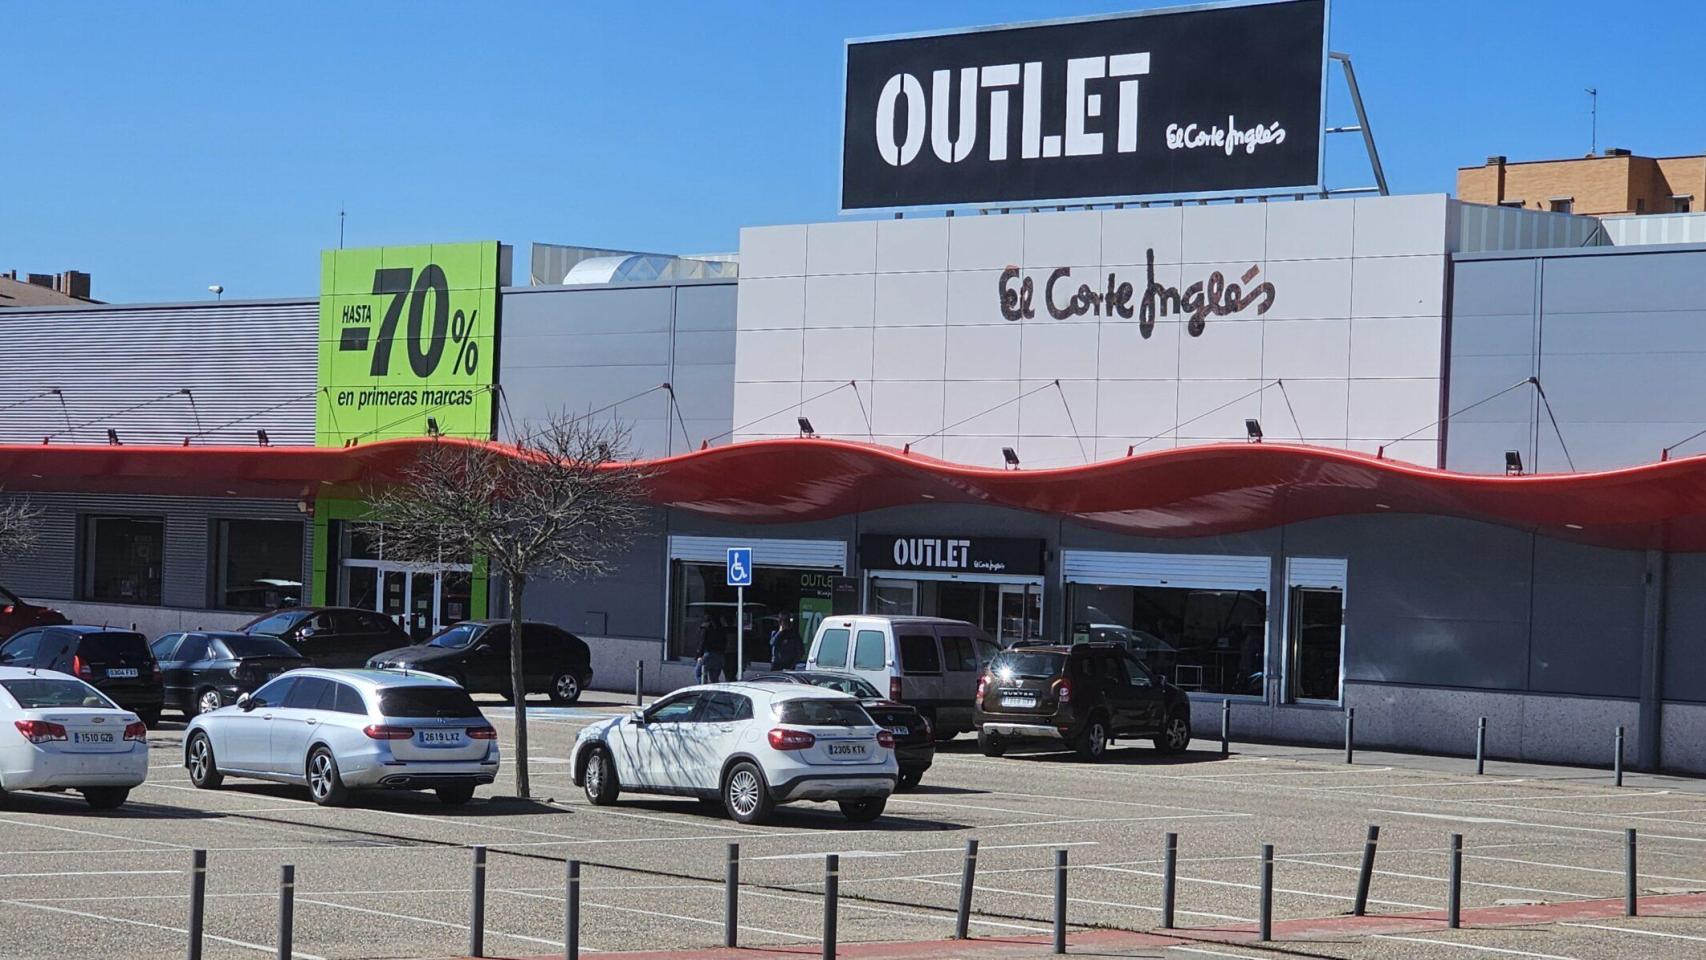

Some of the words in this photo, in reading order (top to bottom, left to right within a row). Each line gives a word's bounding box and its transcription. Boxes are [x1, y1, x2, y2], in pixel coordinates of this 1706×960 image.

[876, 52, 1151, 166] OUTLET
[1166, 123, 1184, 150] El
[1184, 123, 1225, 149] Corte
[1225, 115, 1286, 156] Inglés
[999, 264, 1035, 322] El
[1045, 266, 1134, 320] Corte
[1139, 247, 1276, 340] Inglés
[342, 305, 372, 324] HASTA
[338, 390, 354, 407] en
[358, 387, 417, 411] primeras
[421, 389, 473, 407] marcas
[893, 538, 971, 568] OUTLET
[81, 733, 99, 742] 1510
[425, 732, 444, 741] 2619
[445, 732, 460, 741] LXZ
[833, 745, 851, 754] 2305
[852, 745, 866, 754] KTK
